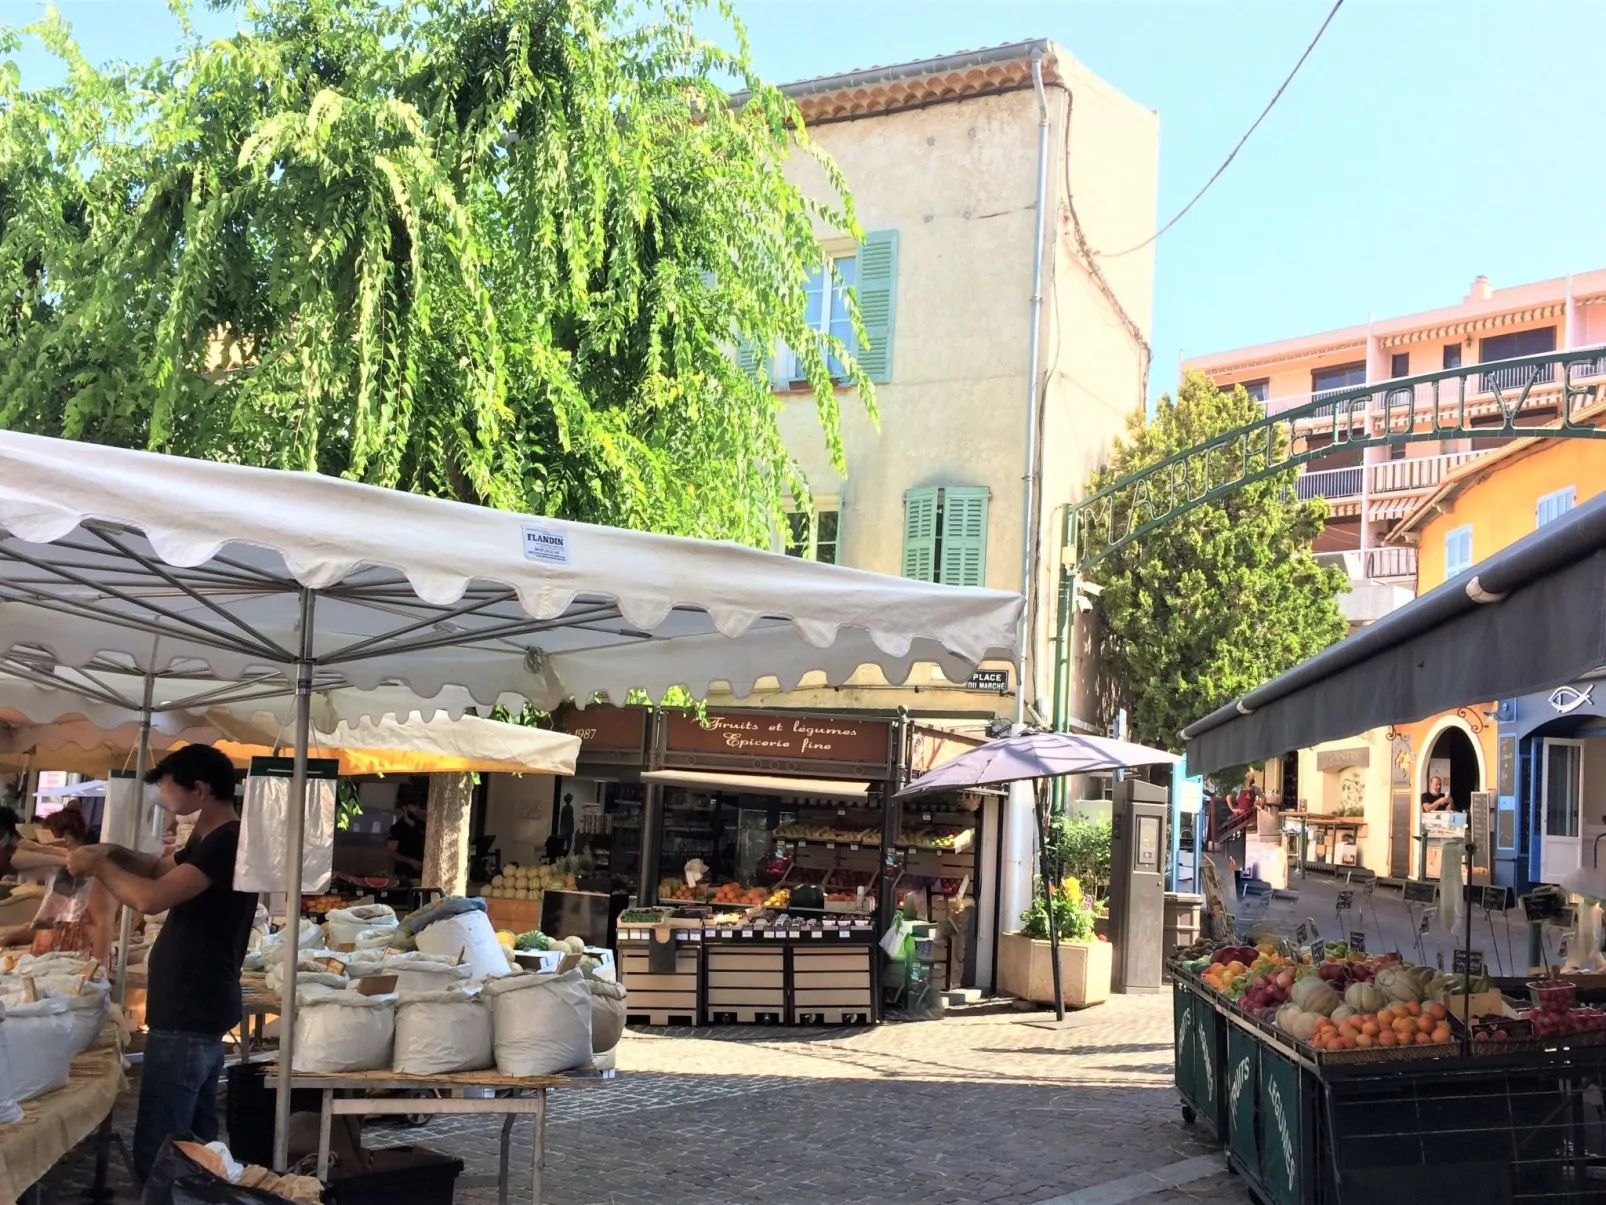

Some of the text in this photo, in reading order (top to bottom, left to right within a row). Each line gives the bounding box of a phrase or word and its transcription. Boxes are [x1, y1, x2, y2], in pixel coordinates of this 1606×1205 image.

[527, 534, 564, 546] FLANDIN
[973, 673, 1002, 682] PLACE
[967, 681, 978, 689] DU
[694, 716, 759, 732] Fruits
[768, 722, 783, 732] et
[575, 728, 597, 739] 1987
[722, 732, 832, 753] Epicerie fine
[1230, 1055, 1251, 1131] FRUITS
[1267, 1073, 1296, 1192] LEGUMES
